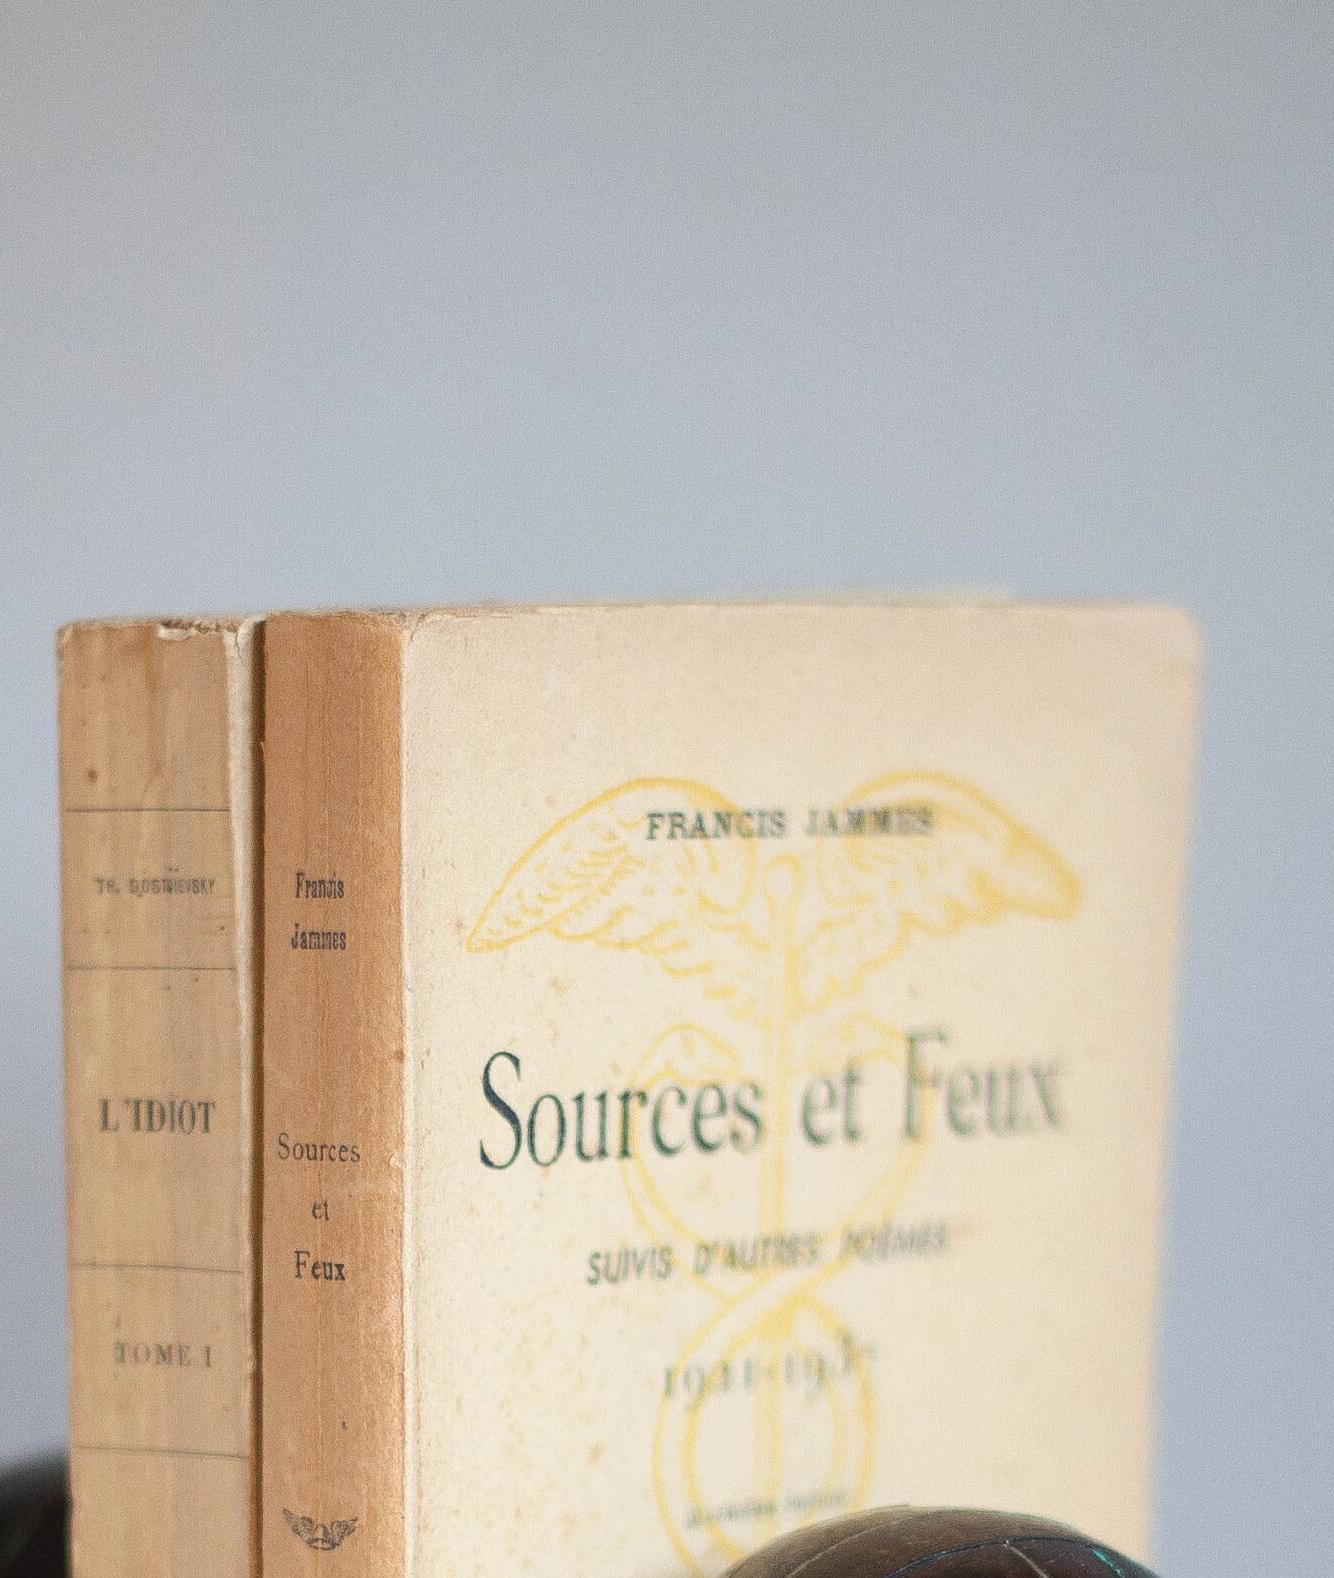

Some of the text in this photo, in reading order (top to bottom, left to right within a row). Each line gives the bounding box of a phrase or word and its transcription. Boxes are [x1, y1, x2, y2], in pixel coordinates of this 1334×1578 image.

[645, 808, 786, 841] FRANCIS
[295, 872, 345, 899] Francis
[291, 923, 347, 950] Jammes
[479, 1028, 1063, 1170] Sources et Feux
[99, 1099, 215, 1134] L'IDIOT
[278, 1132, 361, 1163] Sources
[312, 1200, 330, 1221] et
[294, 1250, 346, 1281] Feux
[587, 1246, 673, 1285] SUIVIS
[116, 1343, 191, 1367] TOME
